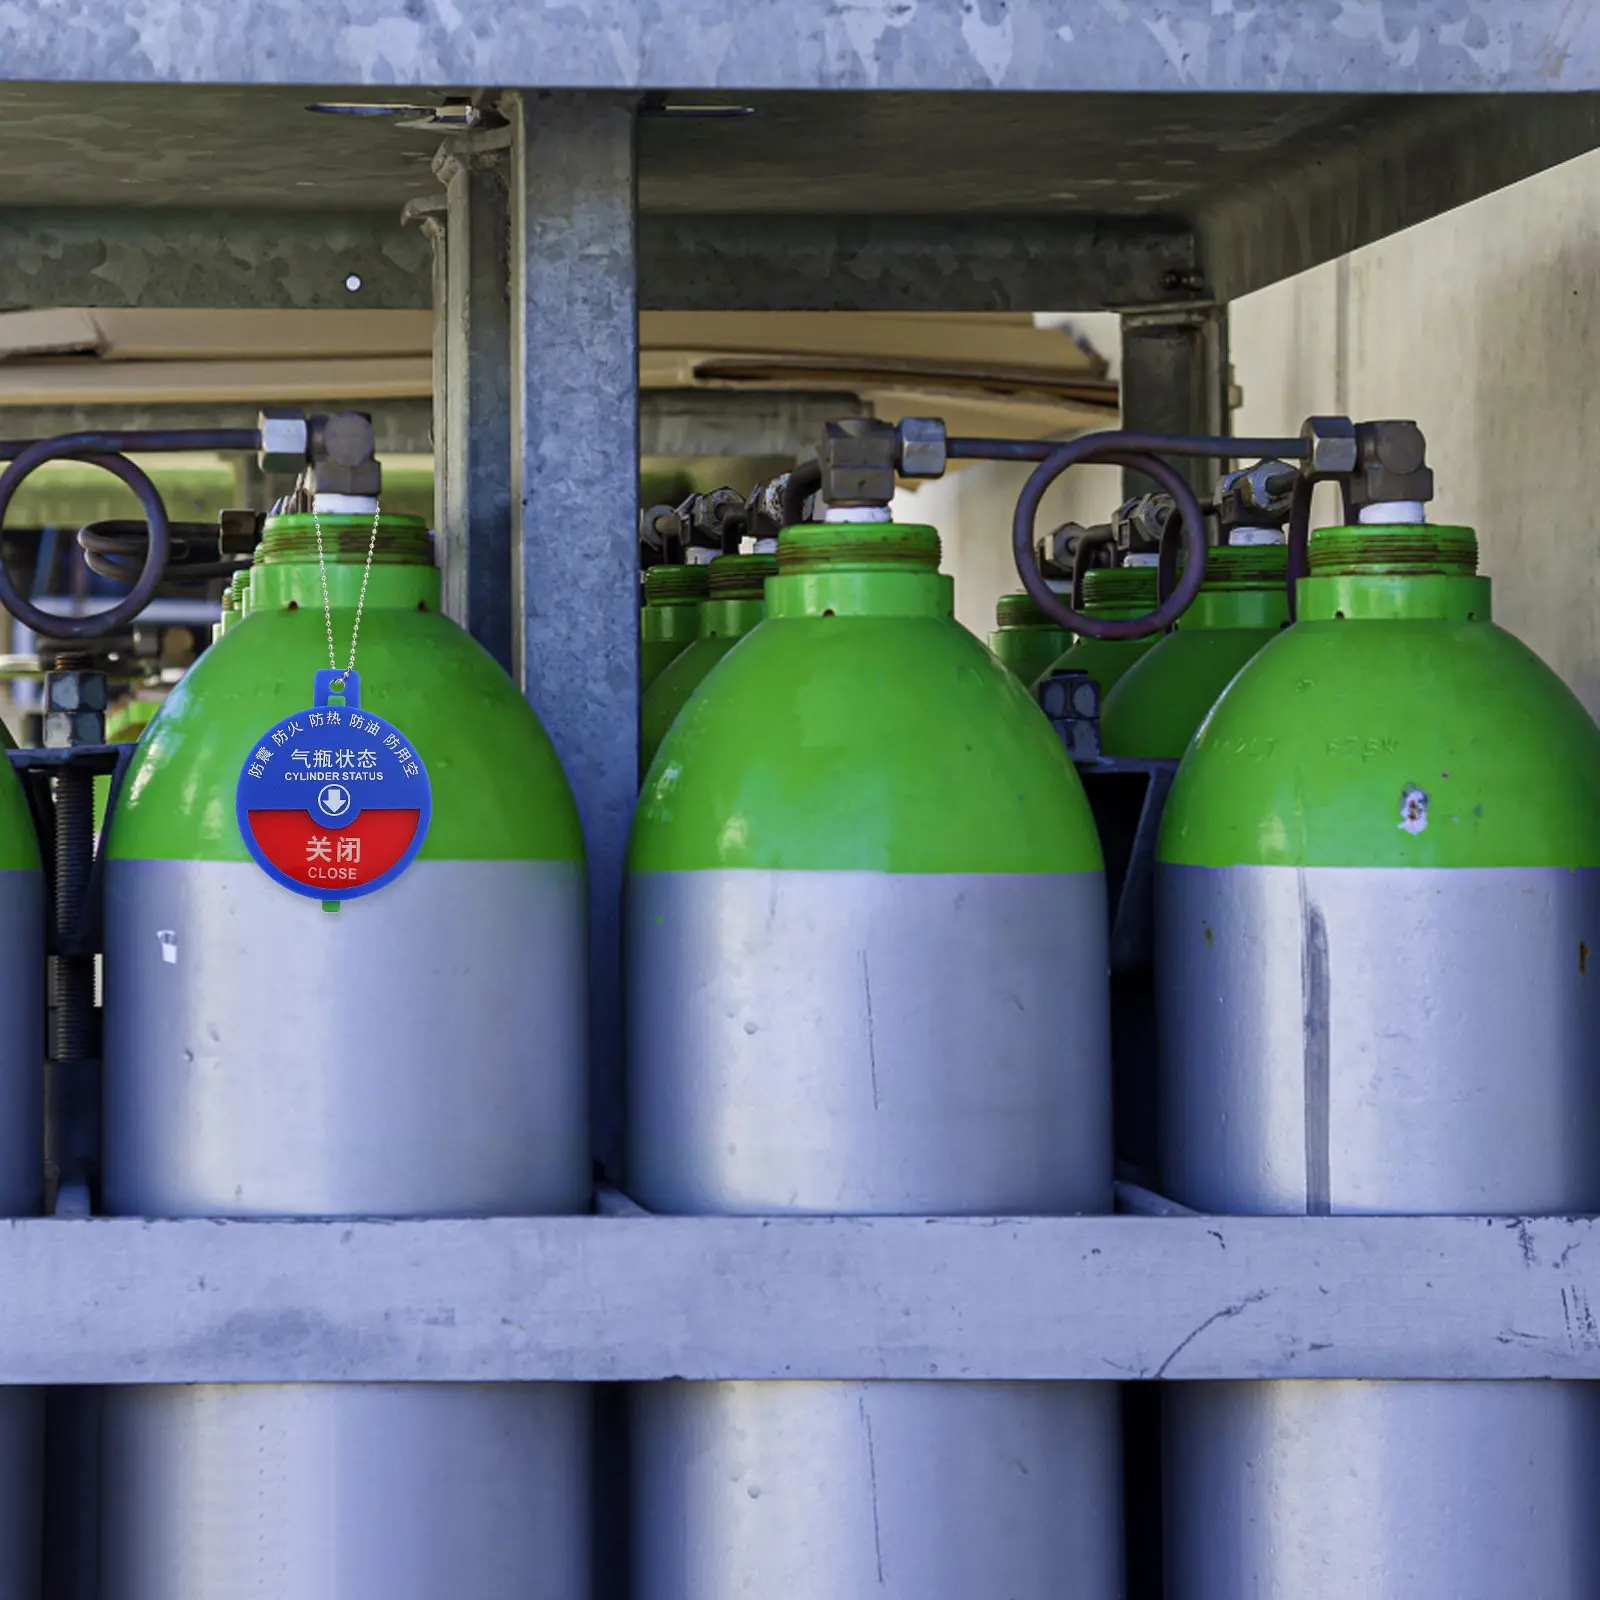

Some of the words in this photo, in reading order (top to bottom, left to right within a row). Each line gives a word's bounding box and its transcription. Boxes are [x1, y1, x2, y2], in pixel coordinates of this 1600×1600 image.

[271, 721, 303, 747] 防火
[308, 710, 342, 728] 防热
[349, 713, 380, 737] 防油
[382, 733, 419, 779] 防用空
[290, 748, 378, 769] 气瓶状态
[284, 771, 340, 781] CYLINDER
[341, 771, 384, 781] STATUS
[305, 835, 361, 864] 关闭
[308, 866, 357, 880] CLOSE
